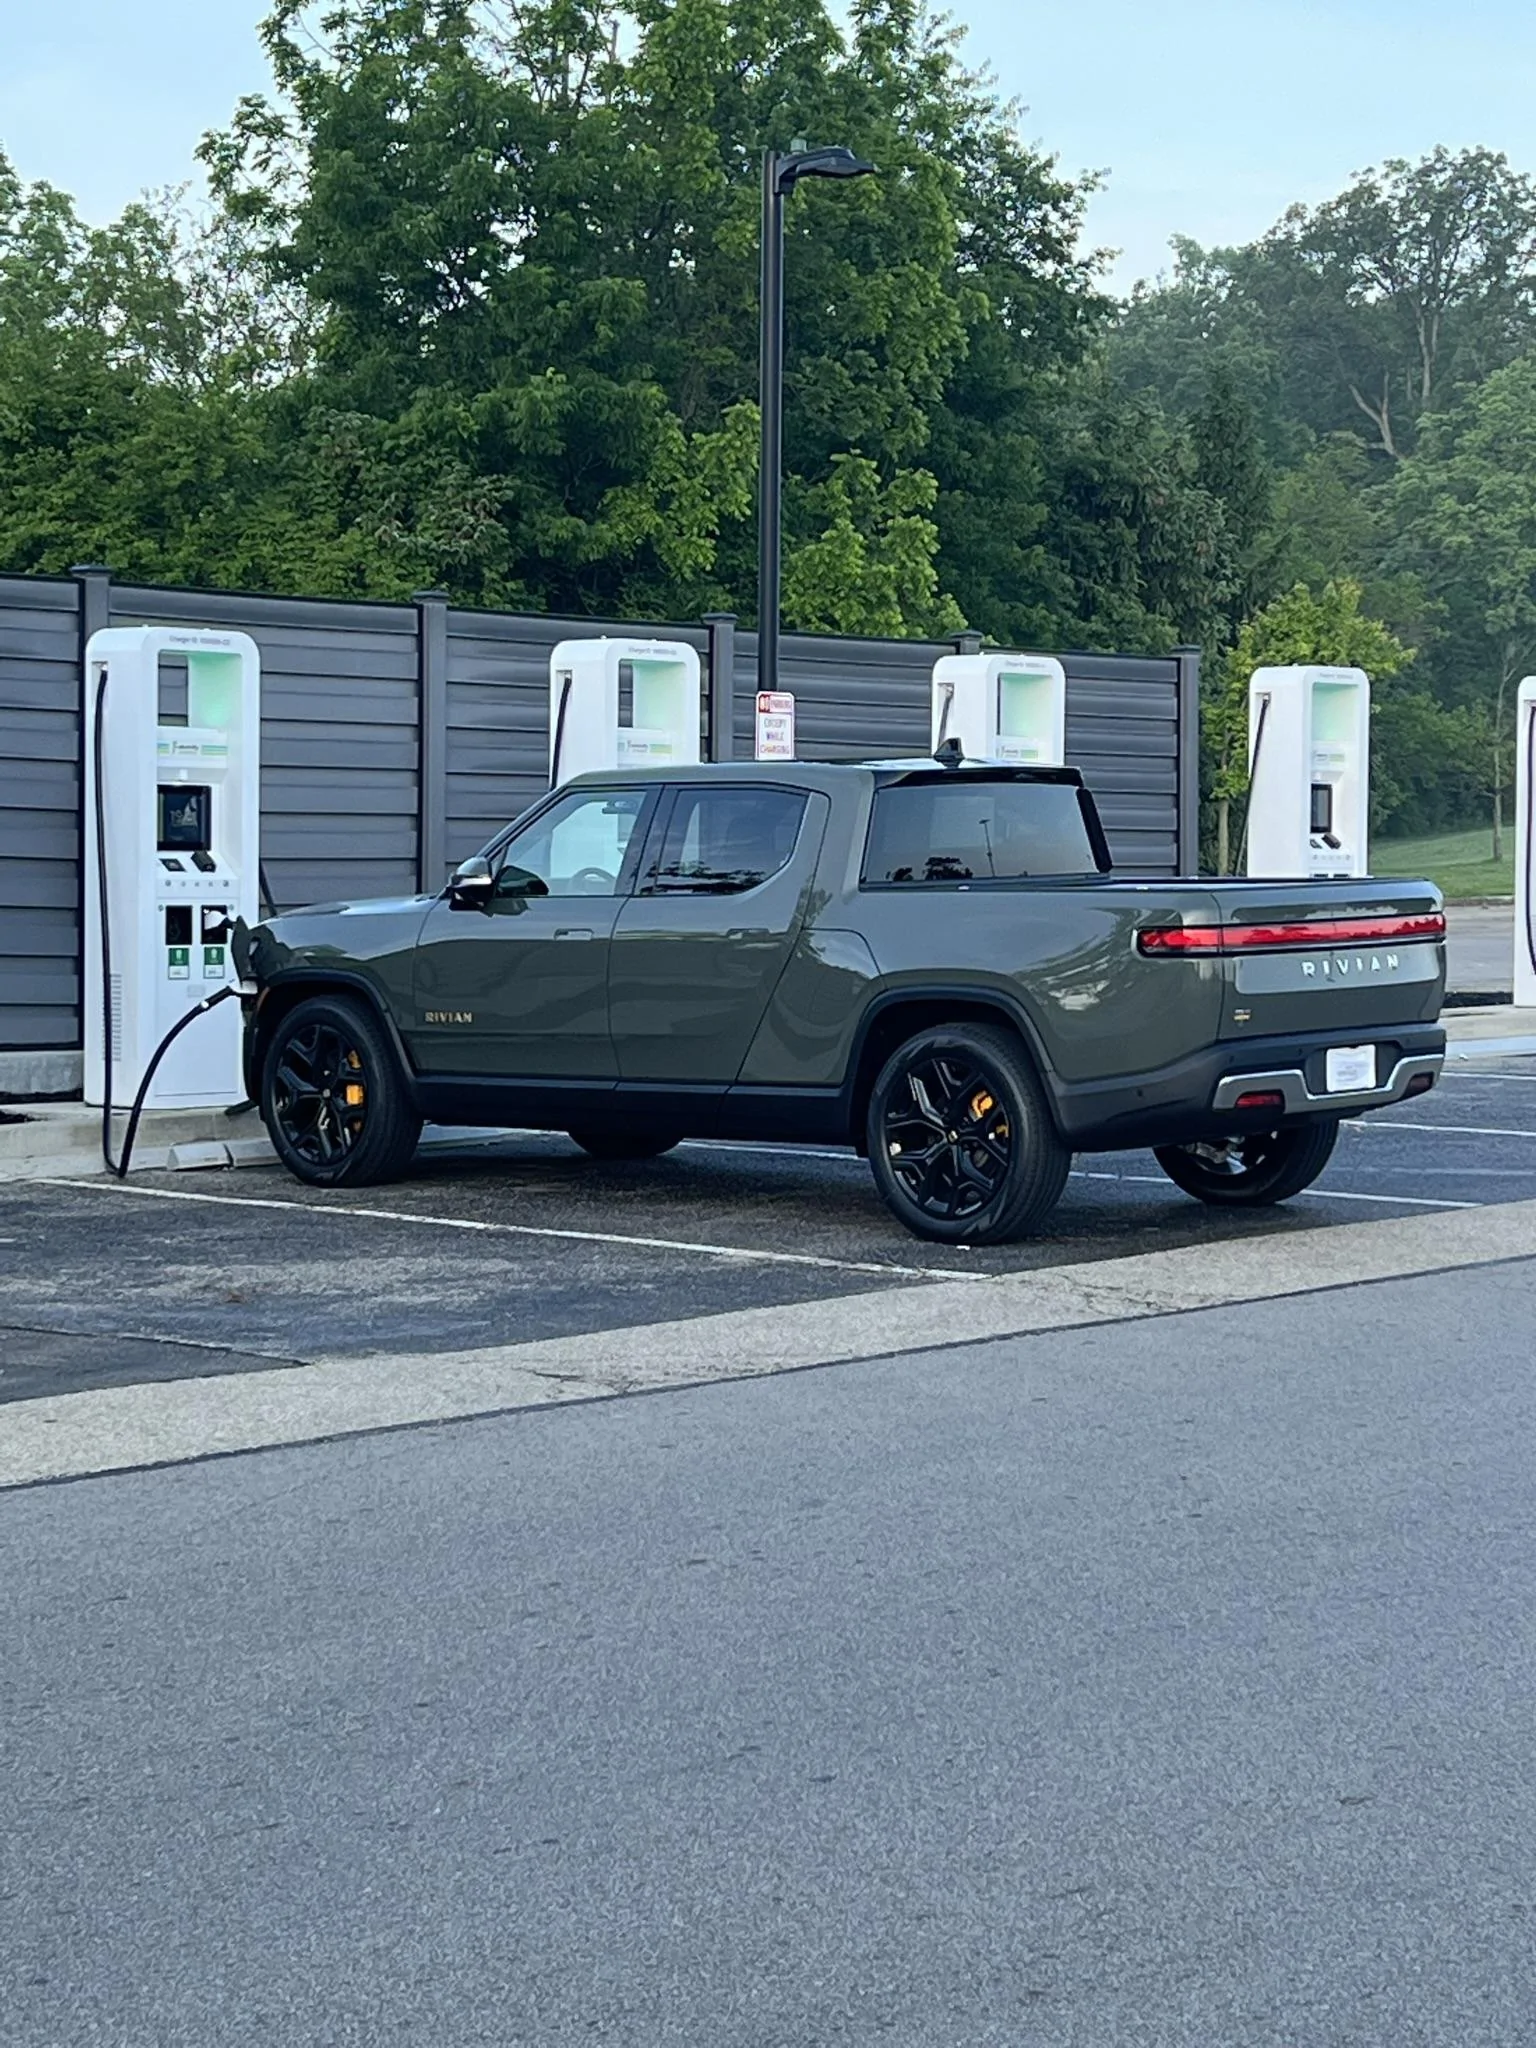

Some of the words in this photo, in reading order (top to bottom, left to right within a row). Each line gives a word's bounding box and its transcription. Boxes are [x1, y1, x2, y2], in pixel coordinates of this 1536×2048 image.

[766, 731, 784, 741] WHILE
[760, 744, 790, 754] CHARGING
[1301, 953, 1399, 977] RIVIAN
[424, 1011, 473, 1023] RIVIAN
